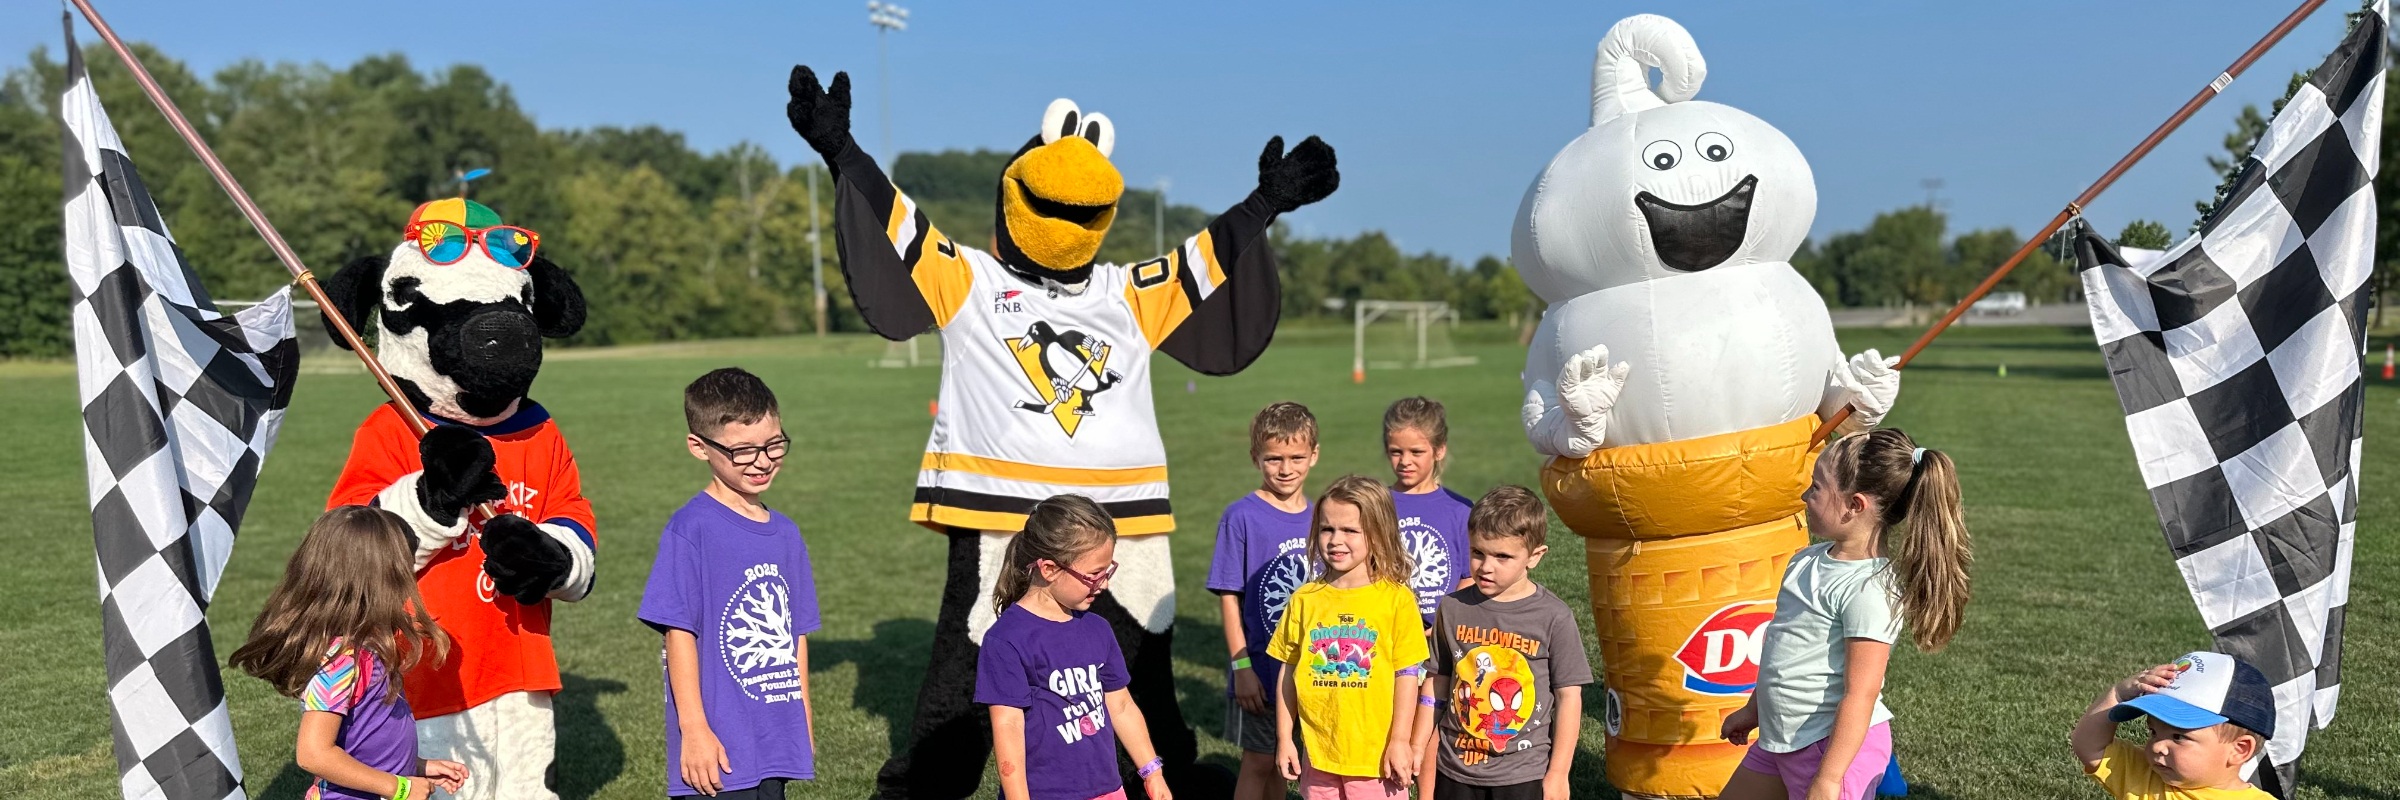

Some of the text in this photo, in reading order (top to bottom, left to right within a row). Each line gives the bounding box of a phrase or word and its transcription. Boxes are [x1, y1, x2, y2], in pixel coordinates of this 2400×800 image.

[994, 302, 1023, 314] F.N.B.
[1398, 516, 1421, 529] 025
[1278, 537, 1307, 553] 2025
[744, 563, 779, 582] 2025
[1456, 625, 1541, 657] HALLOWEEN
[742, 669, 792, 688] Passavant
[1048, 662, 1105, 697] GIRL
[764, 690, 803, 703] Run/W
